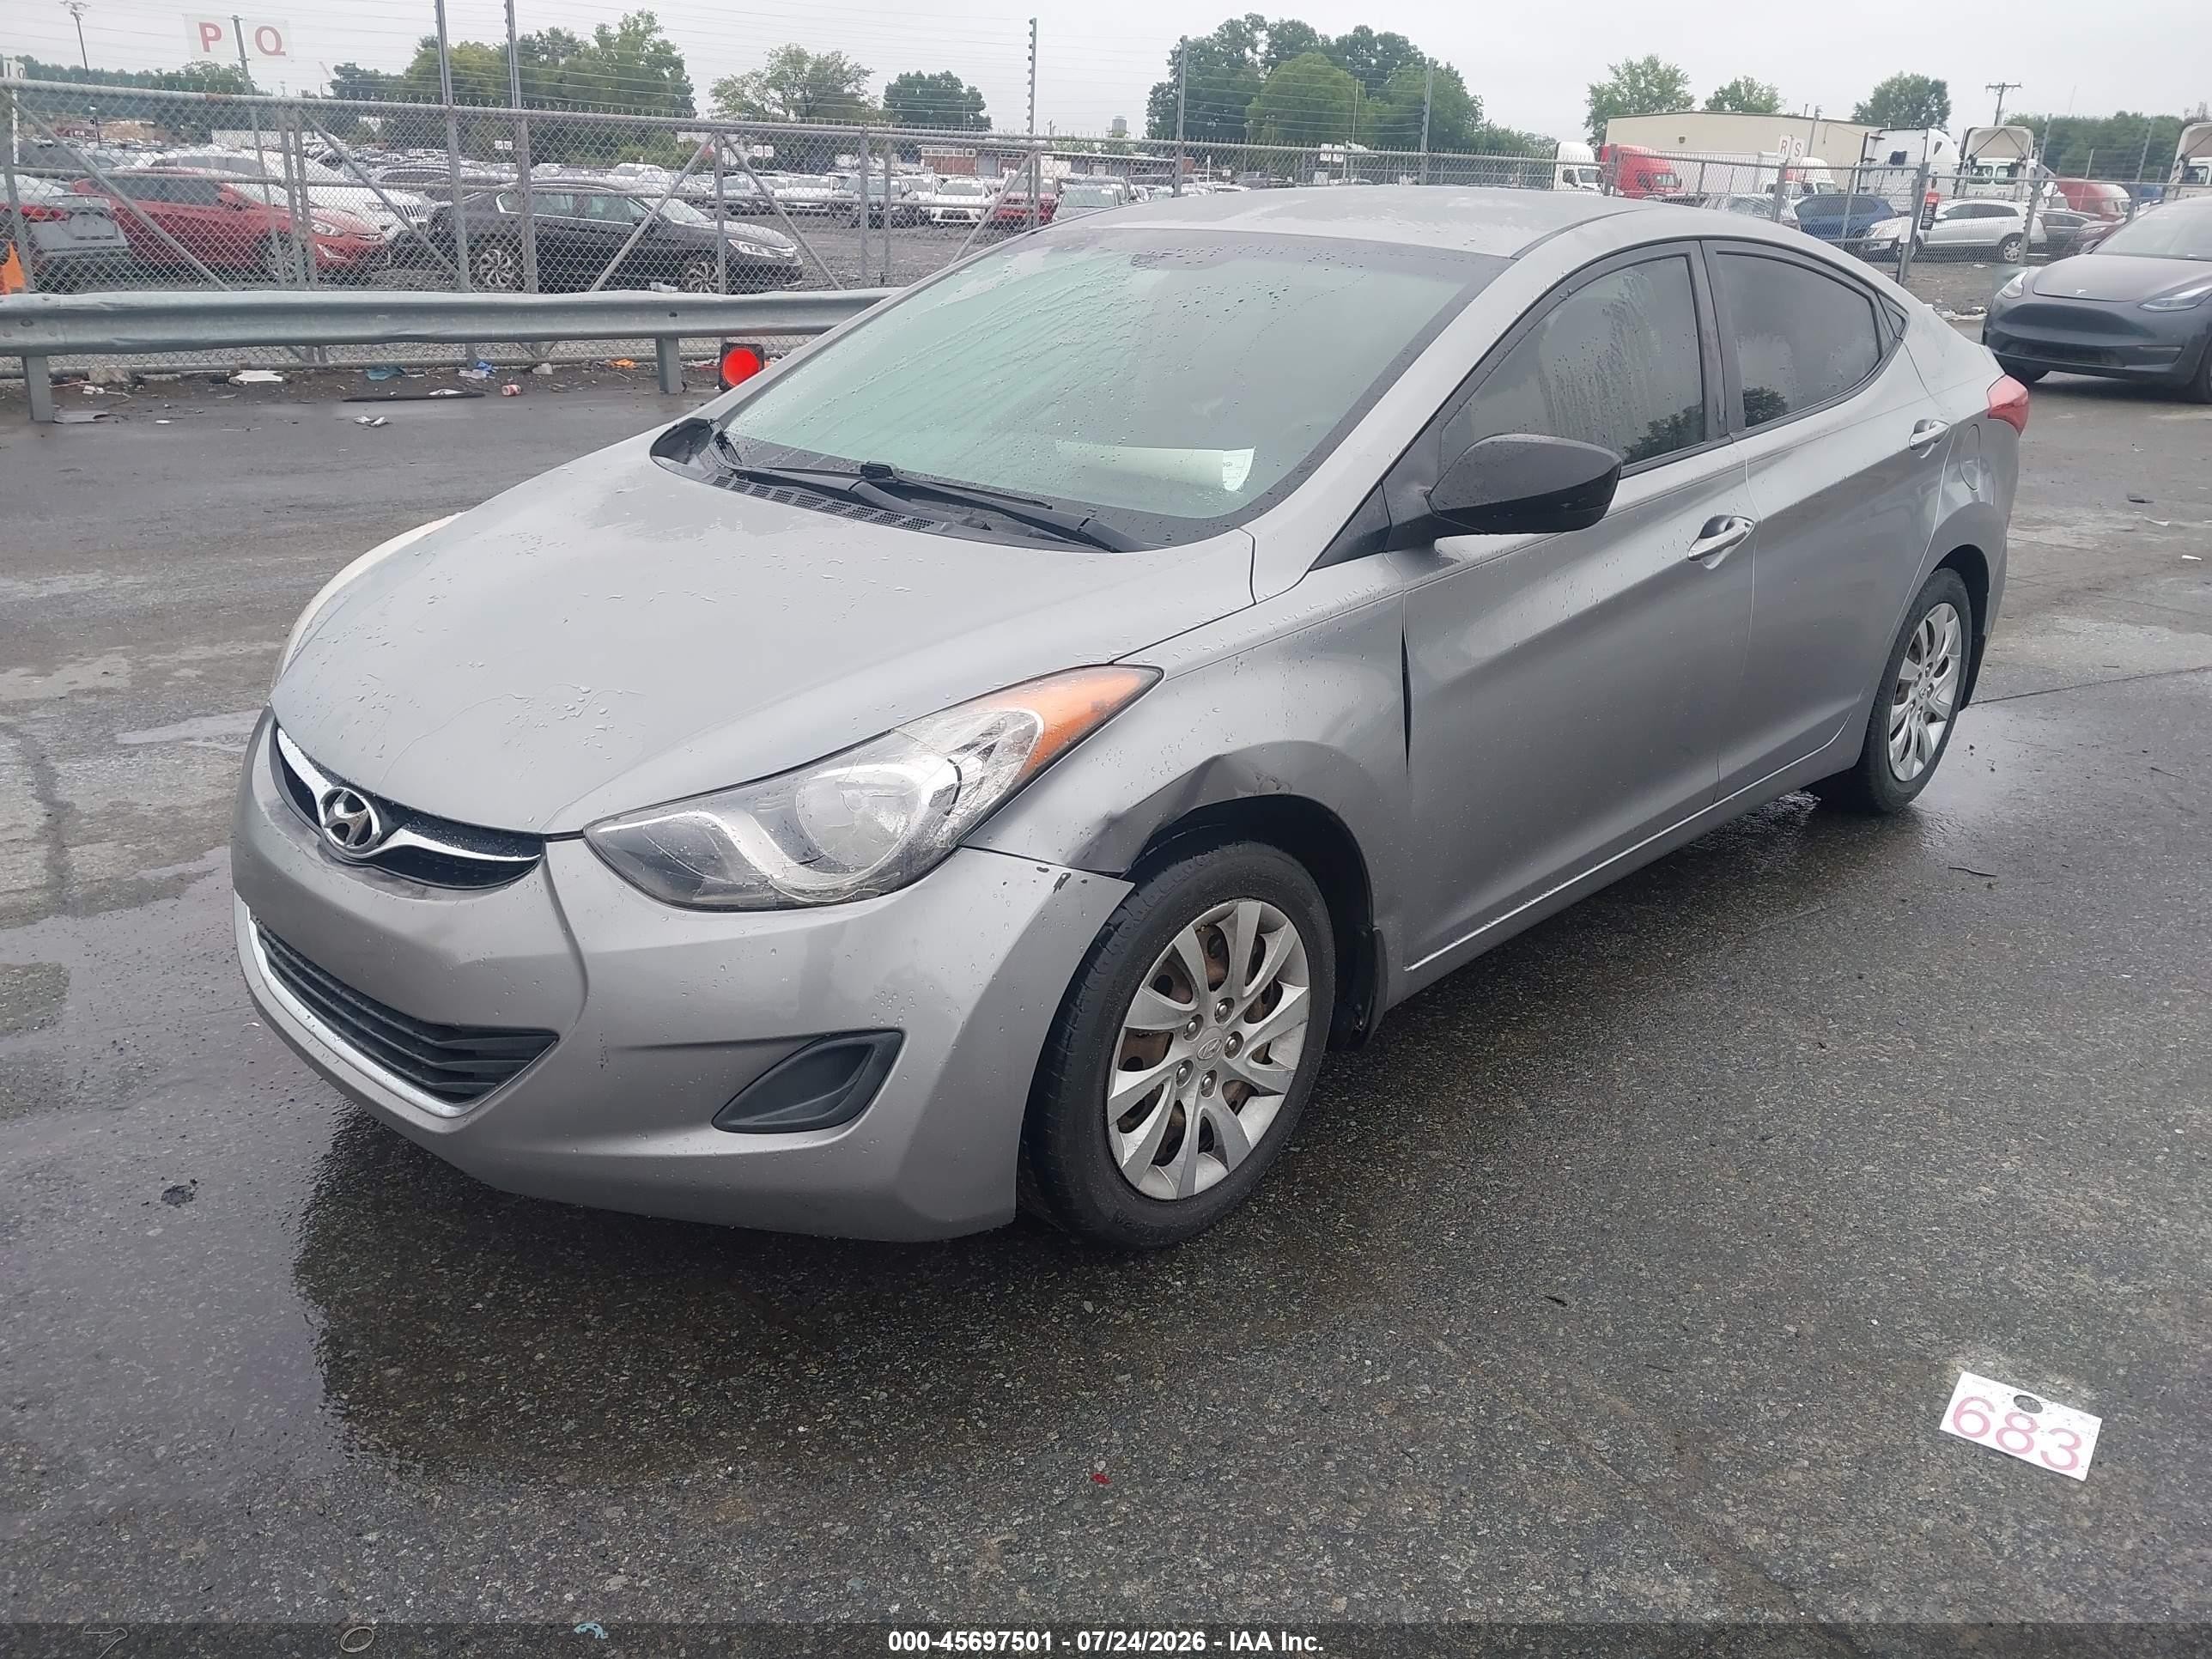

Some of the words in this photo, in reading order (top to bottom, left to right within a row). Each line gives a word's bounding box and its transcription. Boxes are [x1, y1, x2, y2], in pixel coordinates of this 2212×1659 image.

[198, 21, 222, 52] P
[254, 25, 286, 56] Q
[1780, 139, 1788, 155] R
[1794, 142, 1802, 157] S
[1953, 1395, 2082, 1471] 683
